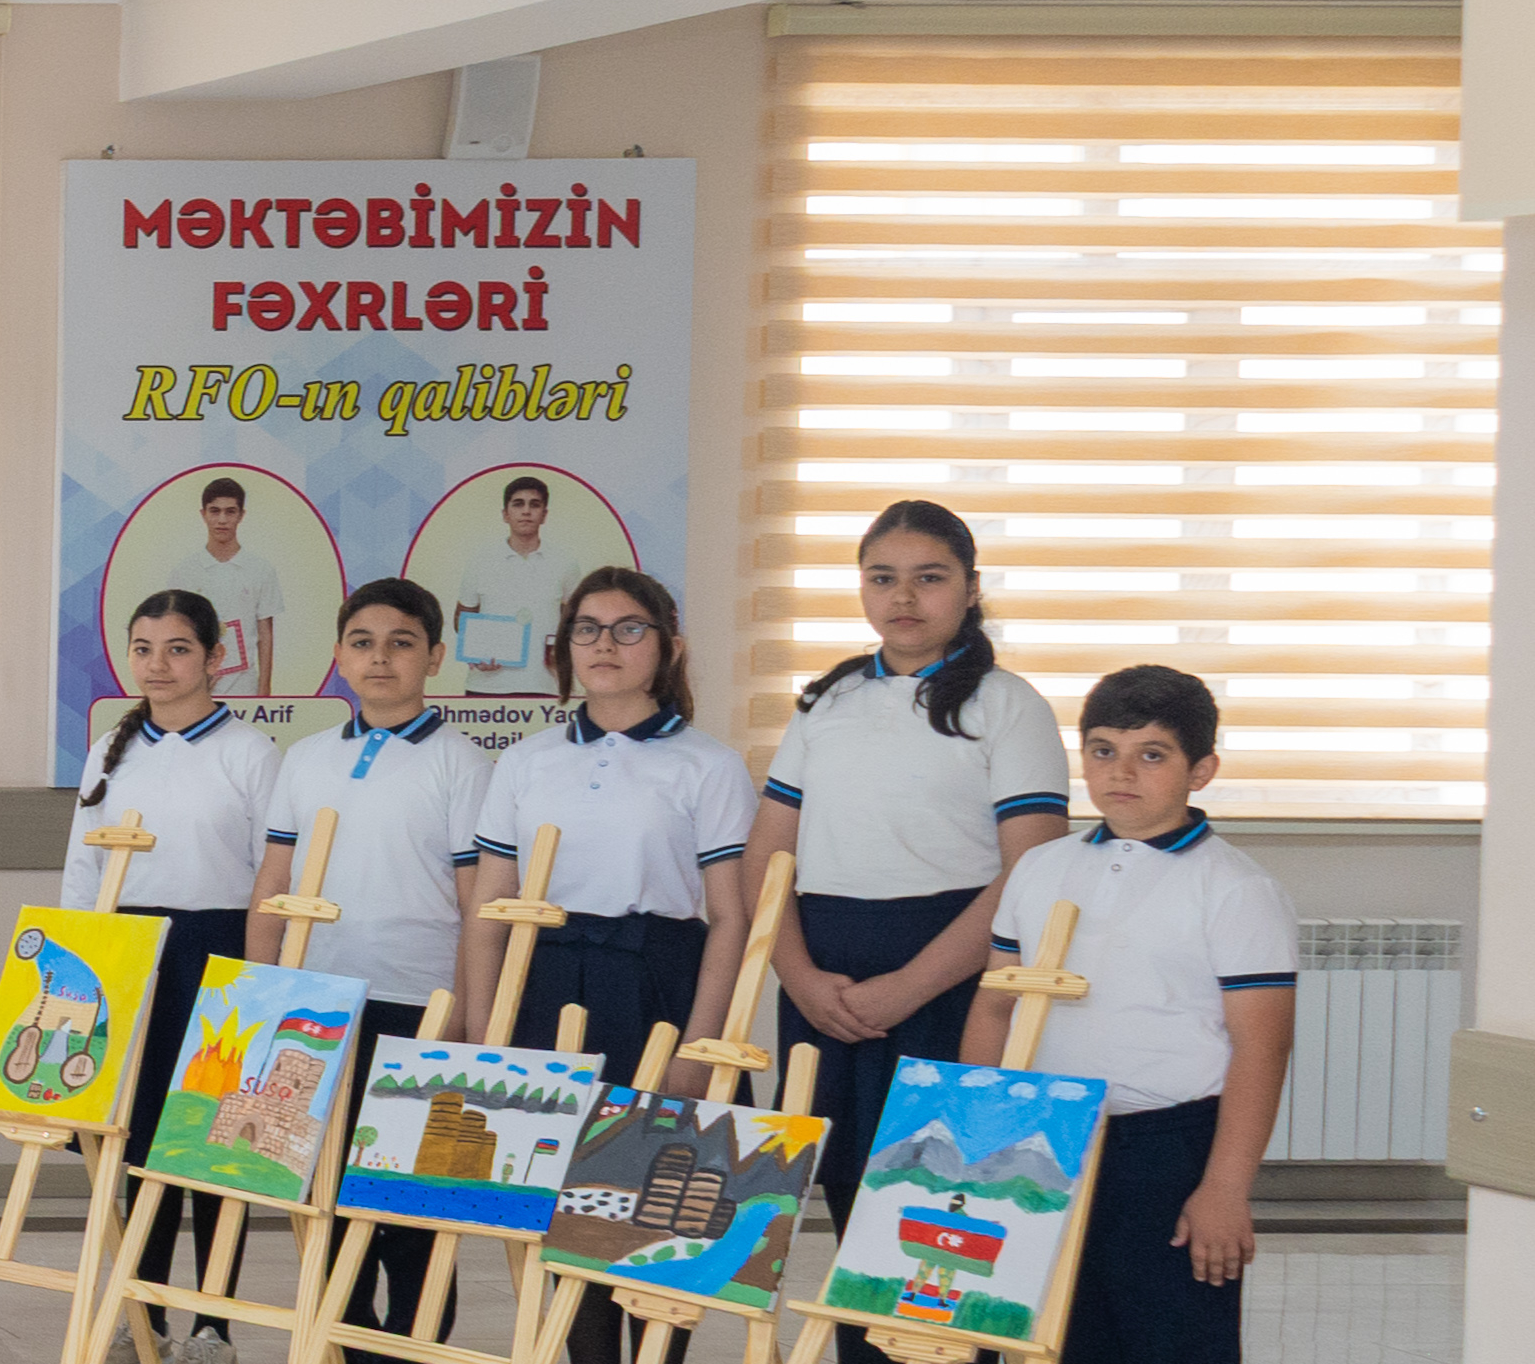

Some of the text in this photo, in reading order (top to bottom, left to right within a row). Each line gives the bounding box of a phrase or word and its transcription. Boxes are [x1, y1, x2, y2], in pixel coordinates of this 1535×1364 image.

[123, 183, 640, 249] MƏKTƏBİMİZİN
[212, 266, 550, 331] FƏXRLƏRİ
[123, 363, 633, 436] RFO-ın qalibləri
[252, 704, 294, 722] Arif
